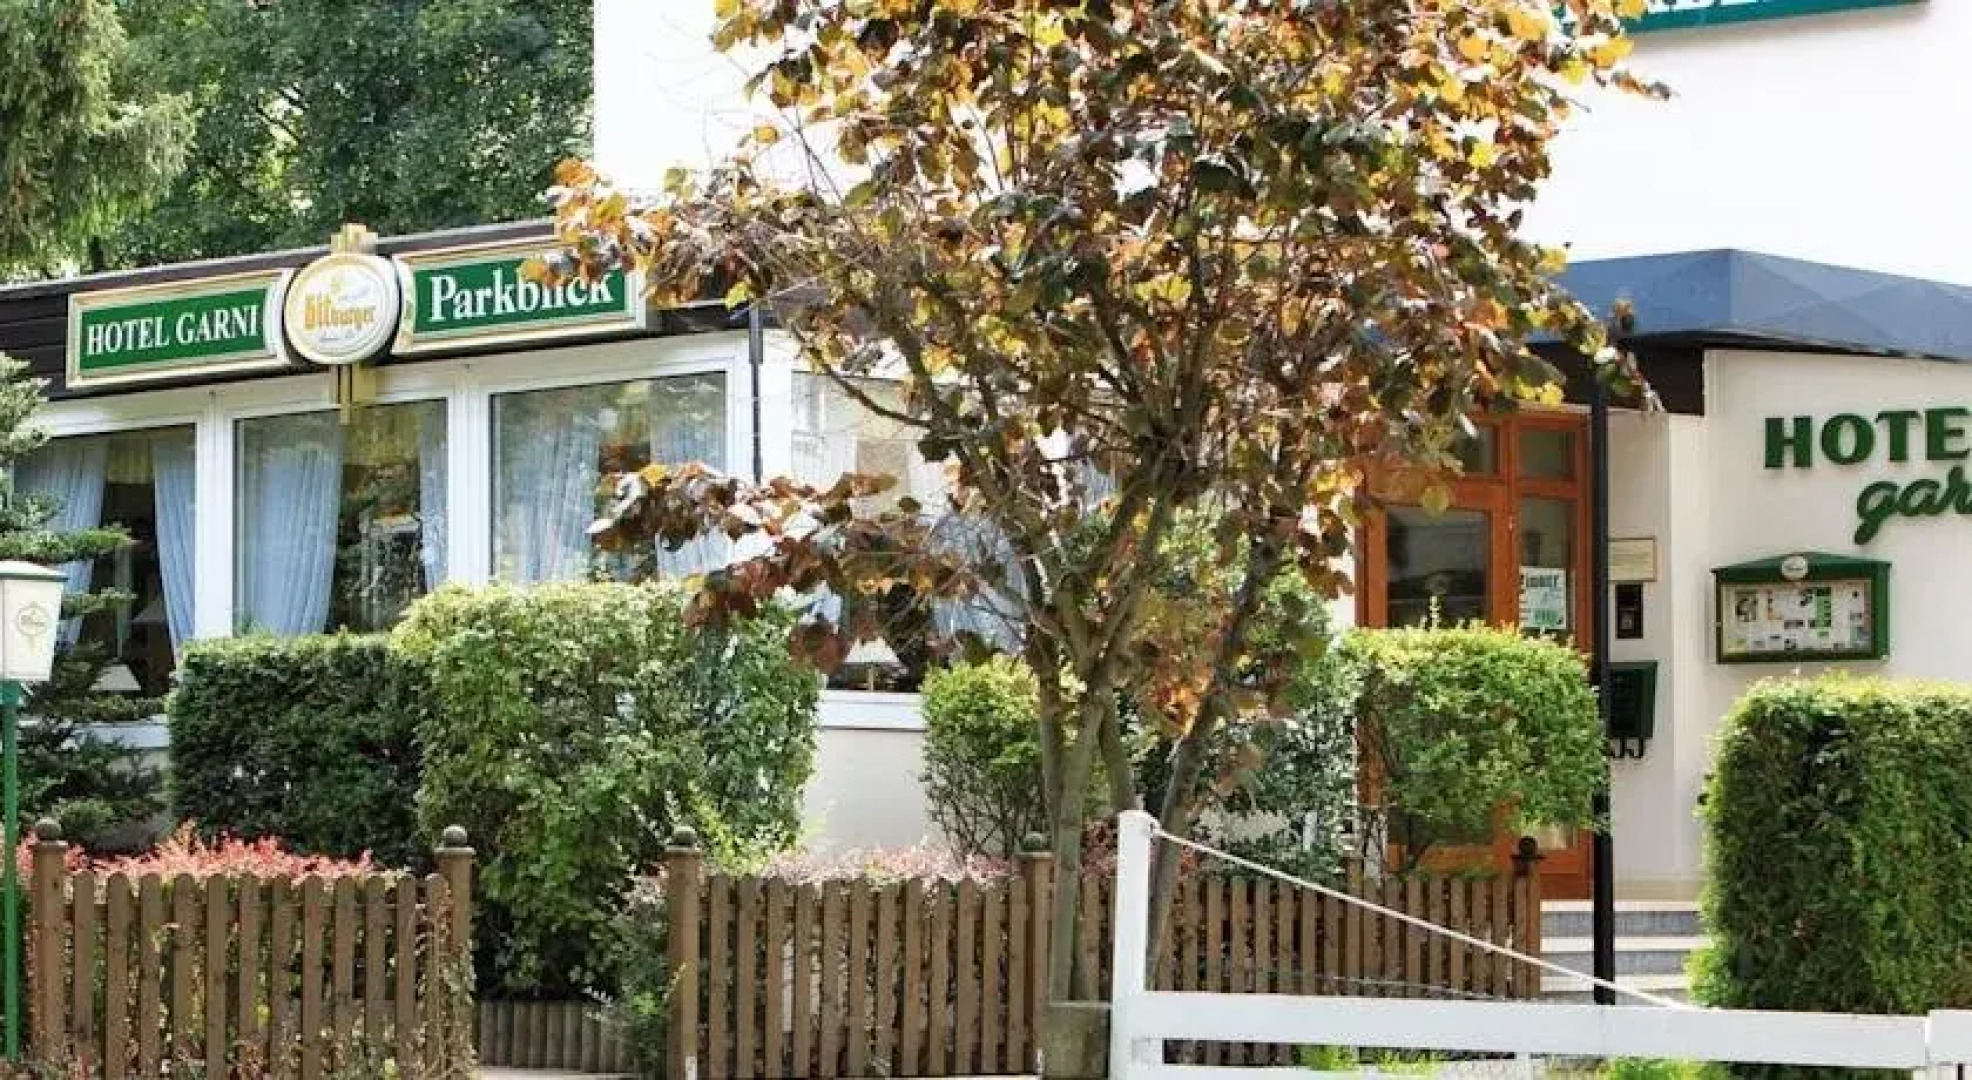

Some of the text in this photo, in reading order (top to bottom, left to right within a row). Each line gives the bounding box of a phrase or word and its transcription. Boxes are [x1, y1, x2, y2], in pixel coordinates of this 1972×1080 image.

[87, 304, 259, 356] HOTEL GARNI
[1764, 407, 1971, 469] HOTE
